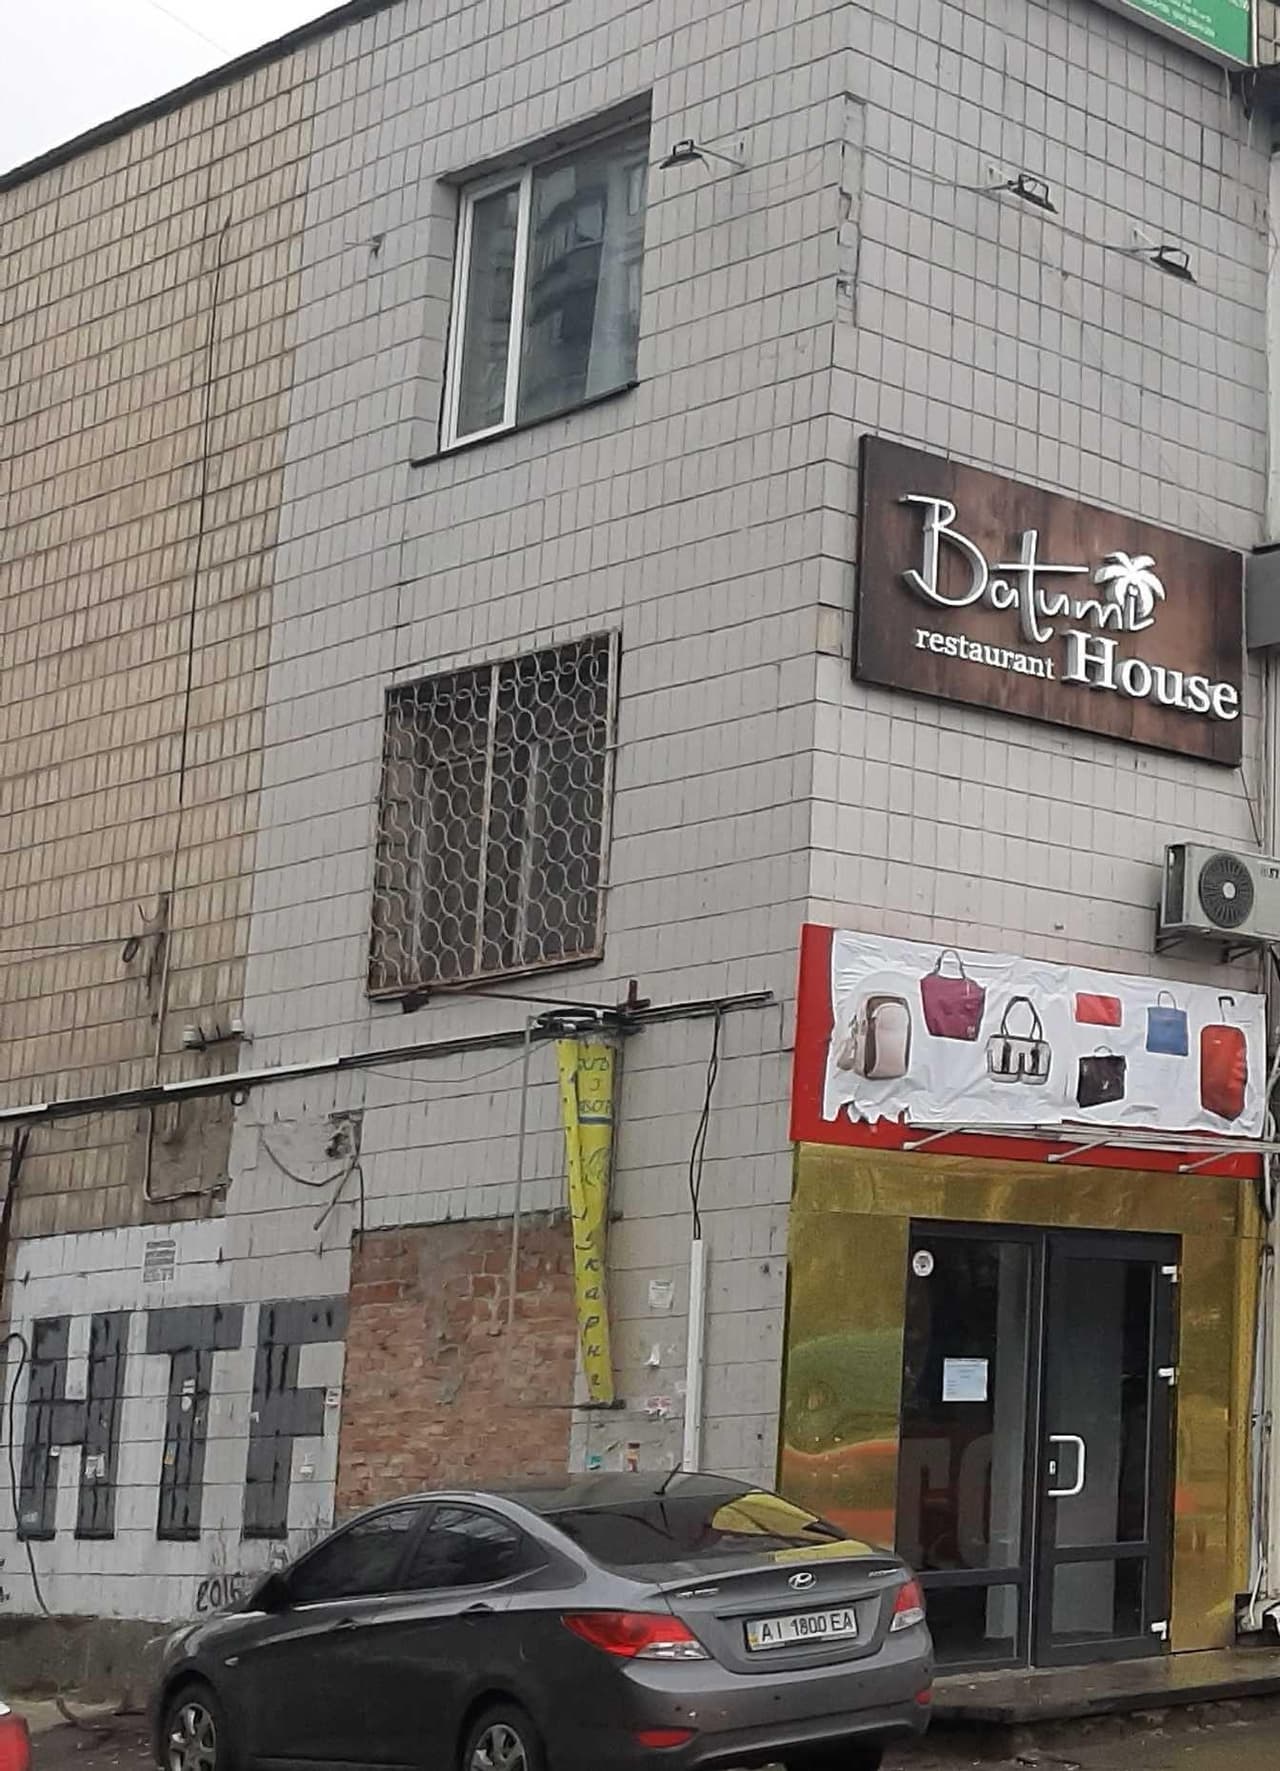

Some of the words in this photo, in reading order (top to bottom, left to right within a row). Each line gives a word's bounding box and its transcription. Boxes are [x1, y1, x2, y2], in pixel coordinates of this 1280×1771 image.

[900, 494, 1156, 643] Batumi
[914, 627, 1056, 681] restaurant
[1063, 630, 1241, 721] House
[761, 1621, 783, 1643] AI
[792, 1614, 828, 1636] 1800
[831, 1611, 854, 1632] EA
